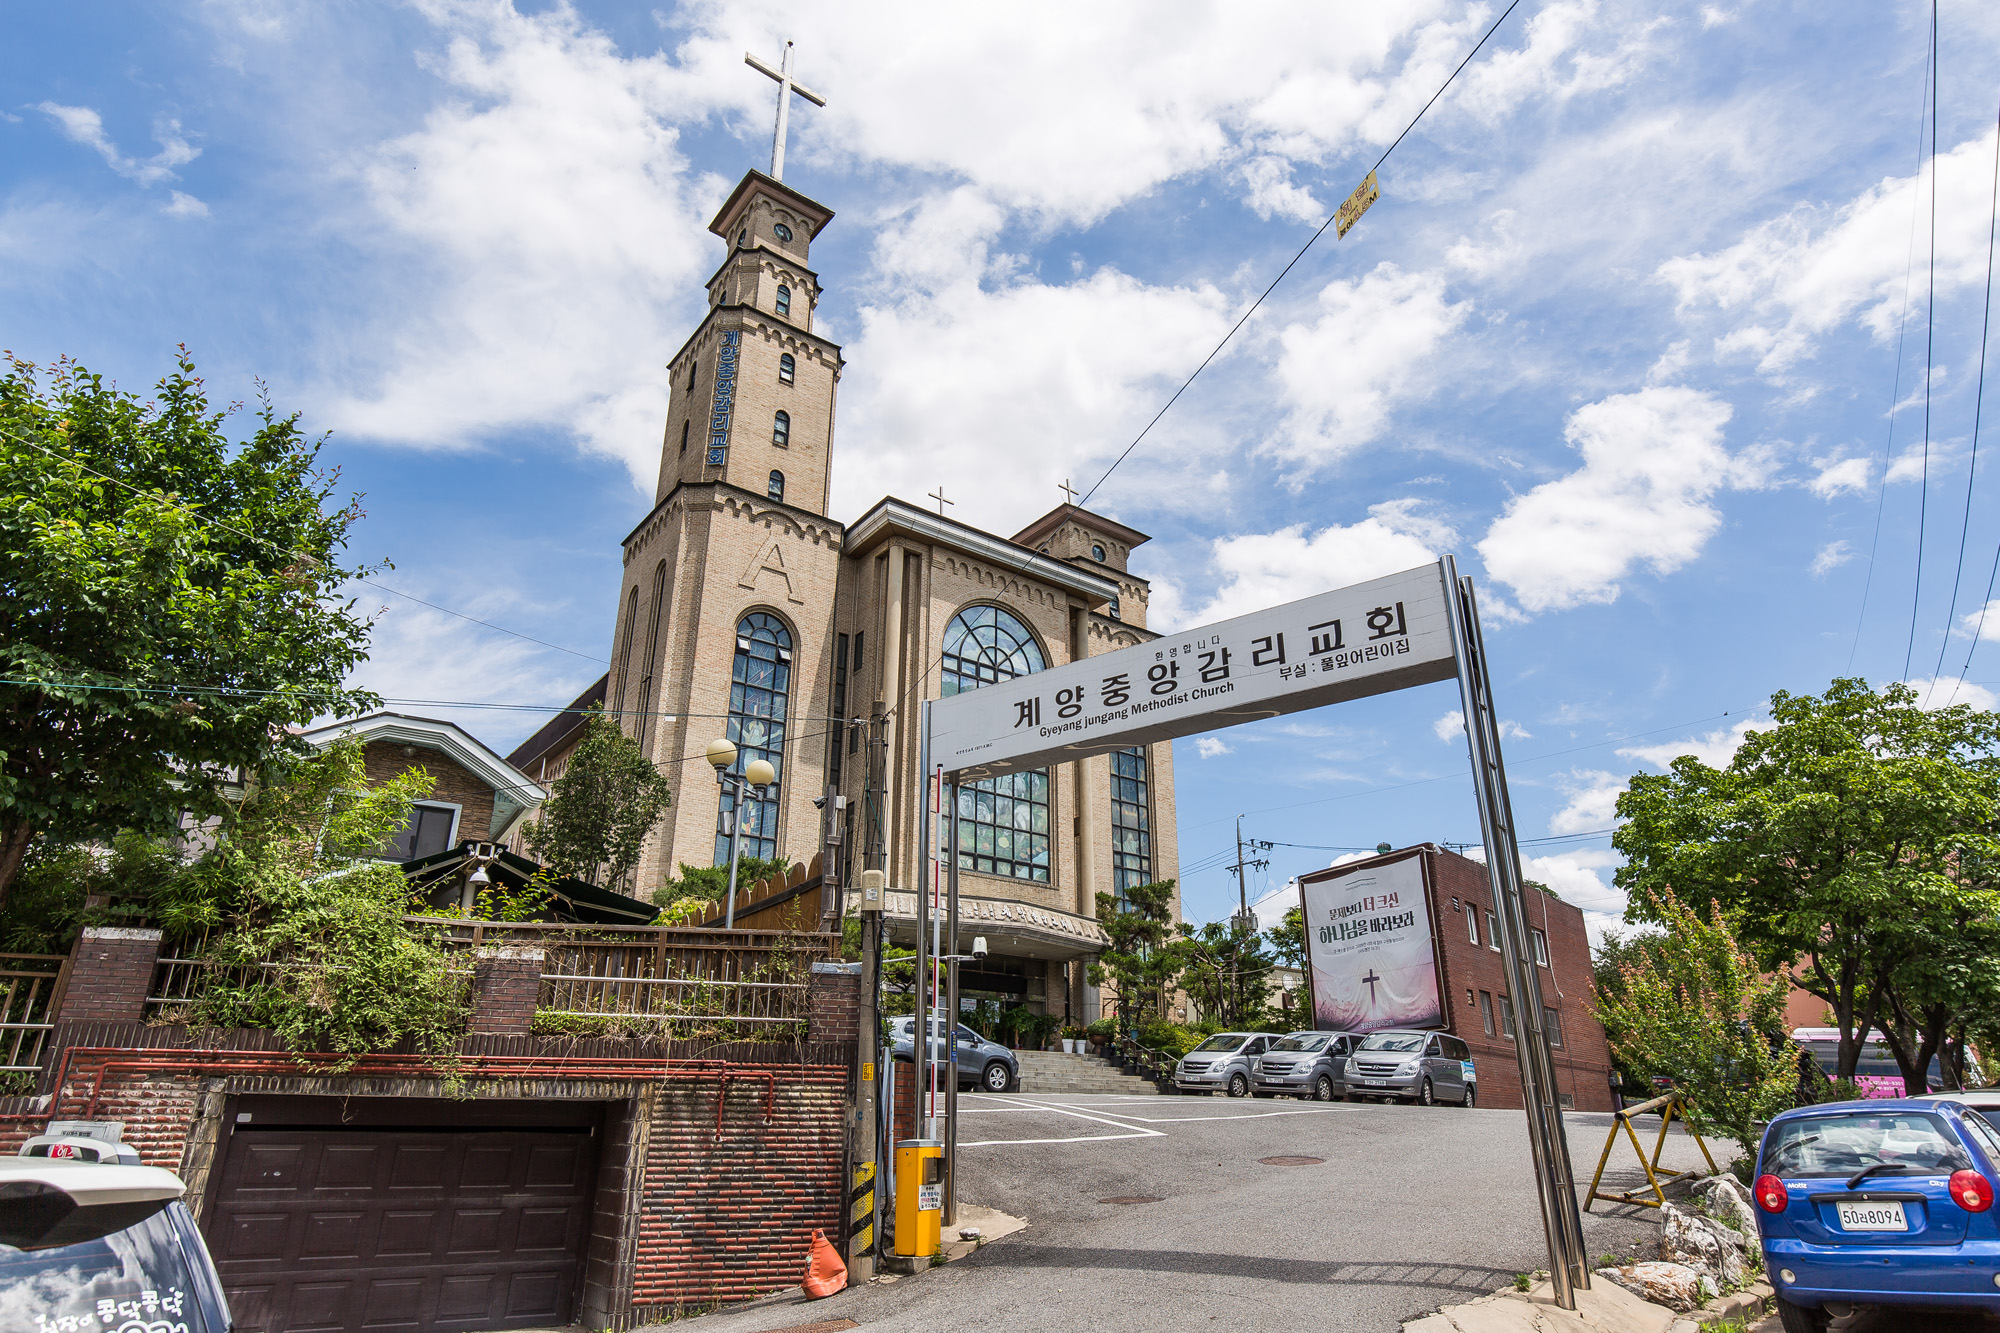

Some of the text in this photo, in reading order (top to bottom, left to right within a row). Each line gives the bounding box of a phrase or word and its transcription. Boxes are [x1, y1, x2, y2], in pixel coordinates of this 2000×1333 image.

[707, 330, 739, 466] 계양중앙감리교회
[1013, 601, 1408, 729] 계양중앙감리교회
[1155, 634, 1220, 662] 환영합니다
[1279, 663, 1307, 682] 부설
[1320, 638, 1410, 673] 풀잎어린이집
[1039, 681, 1234, 738] Gyeyang jungang Methodist Church
[1319, 910, 1414, 944] 하나님을 바라보라
[1329, 891, 1400, 921] 문제보다 더 크신
